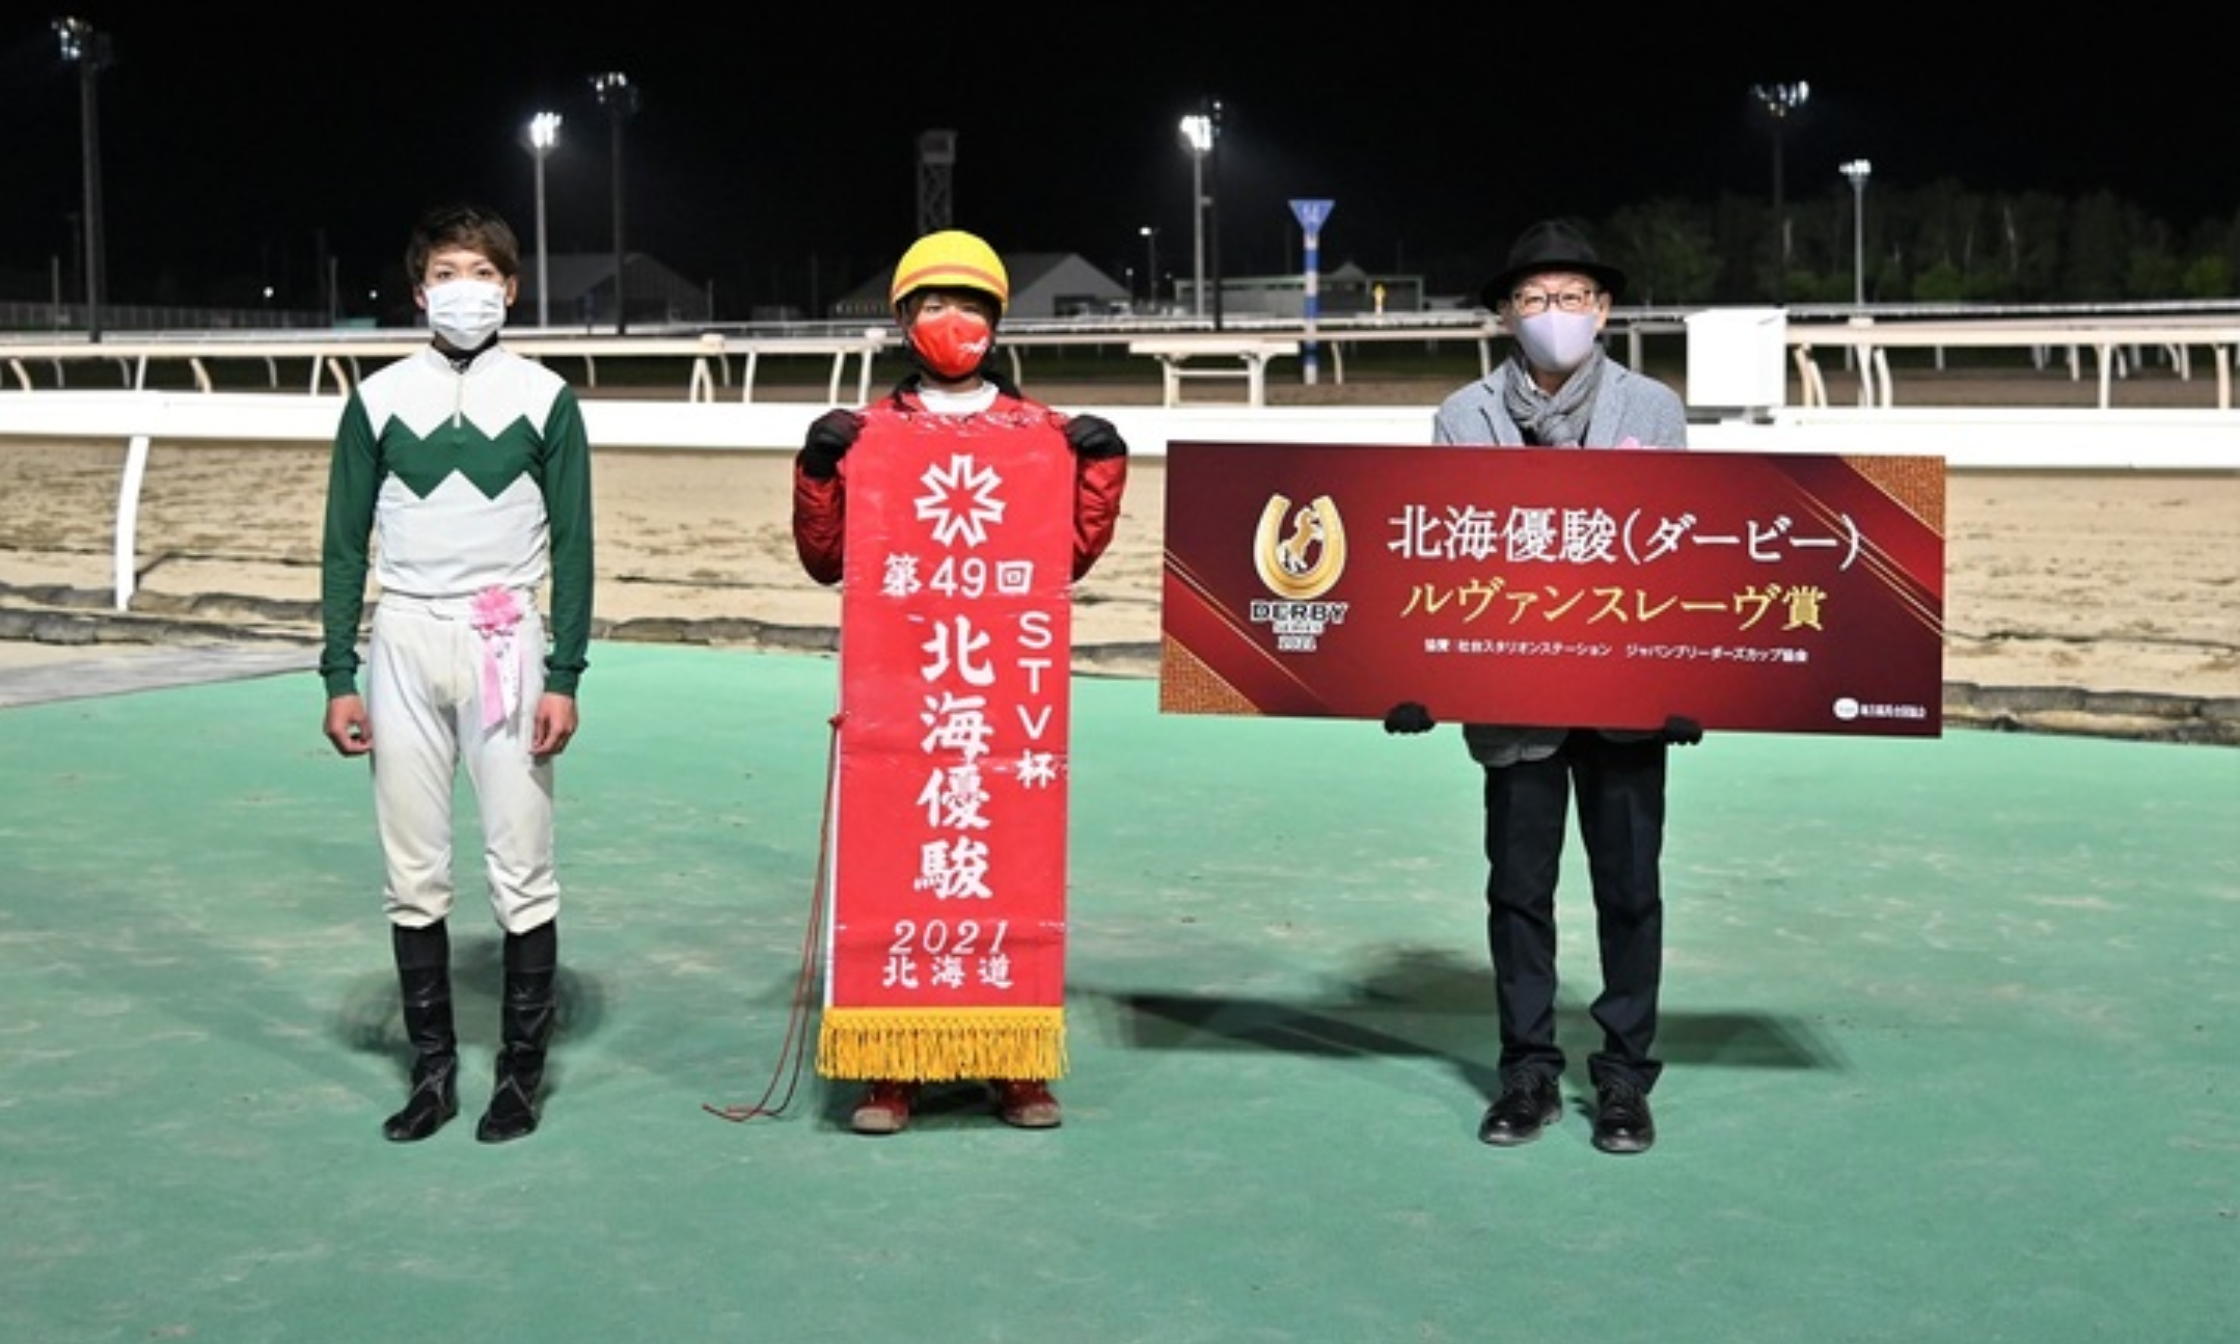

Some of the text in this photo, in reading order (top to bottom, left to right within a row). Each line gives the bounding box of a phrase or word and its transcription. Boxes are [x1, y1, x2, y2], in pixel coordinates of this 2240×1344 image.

[882, 553, 1034, 598] 第49回
[1250, 601, 1348, 623] DERBY
[1401, 576, 1828, 632] ルヴァンスレーヴ賞
[914, 614, 996, 900] 北海優駿
[889, 919, 1009, 955] 2021
[882, 956, 1014, 989] 北海道
